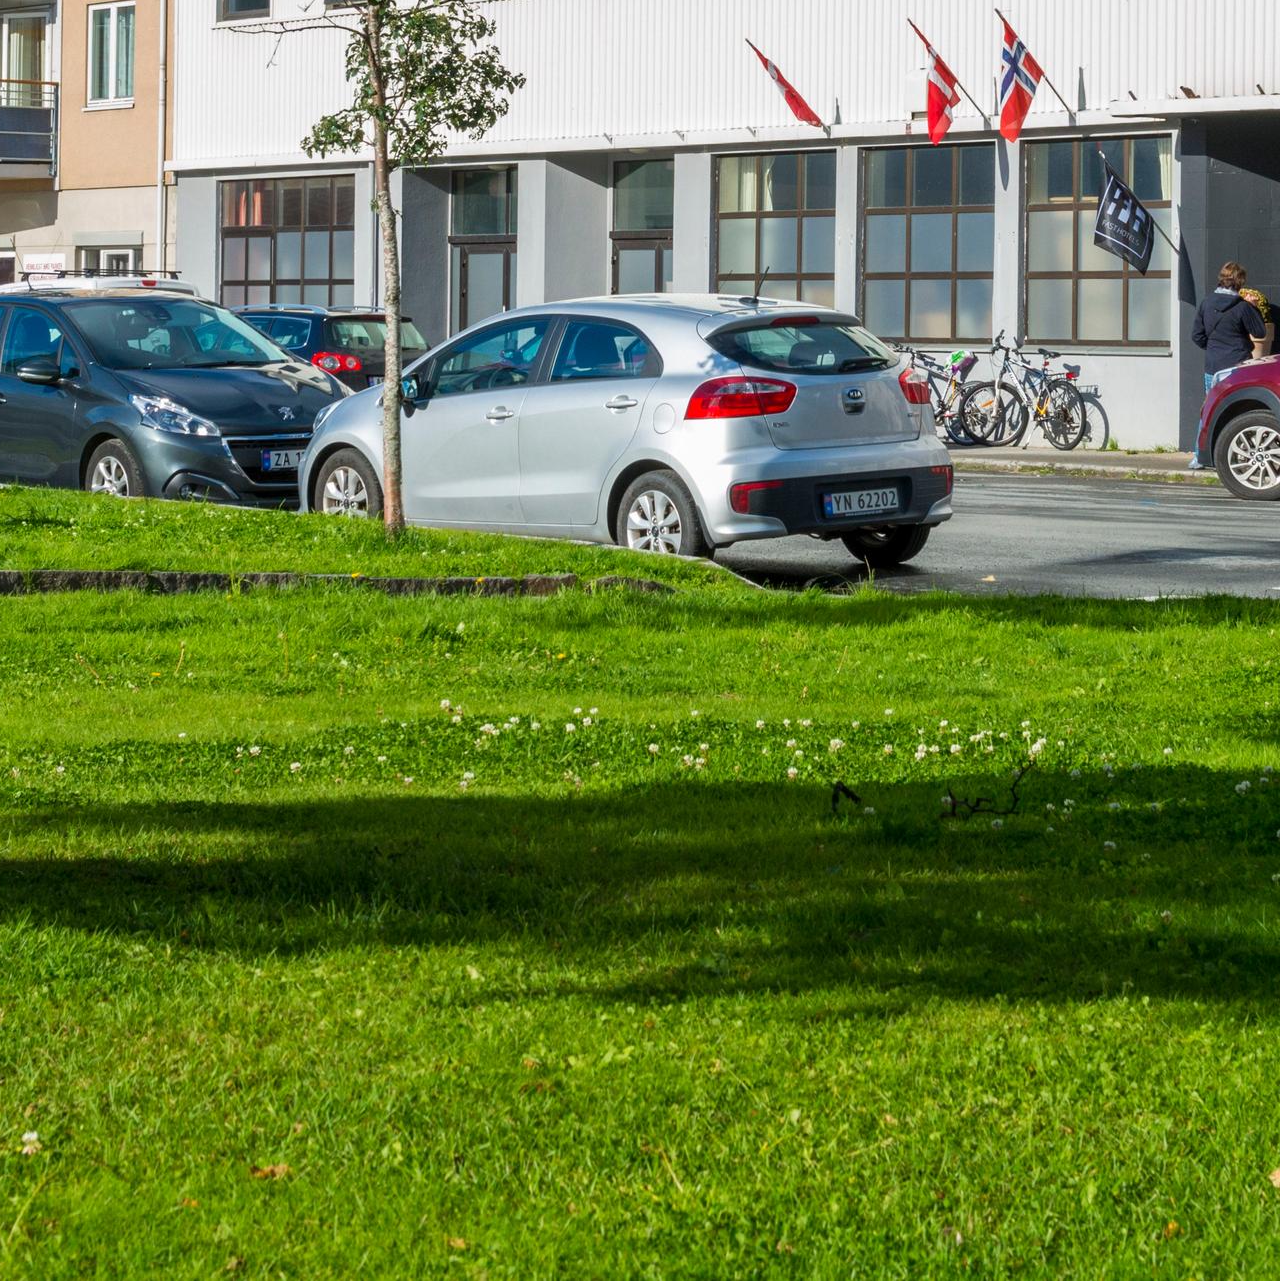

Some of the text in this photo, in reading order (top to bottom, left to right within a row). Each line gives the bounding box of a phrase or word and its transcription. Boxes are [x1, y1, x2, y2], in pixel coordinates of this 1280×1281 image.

[849, 390, 862, 399] KIA
[274, 452, 305, 467] ZA 1
[833, 490, 897, 511] YN 62202
